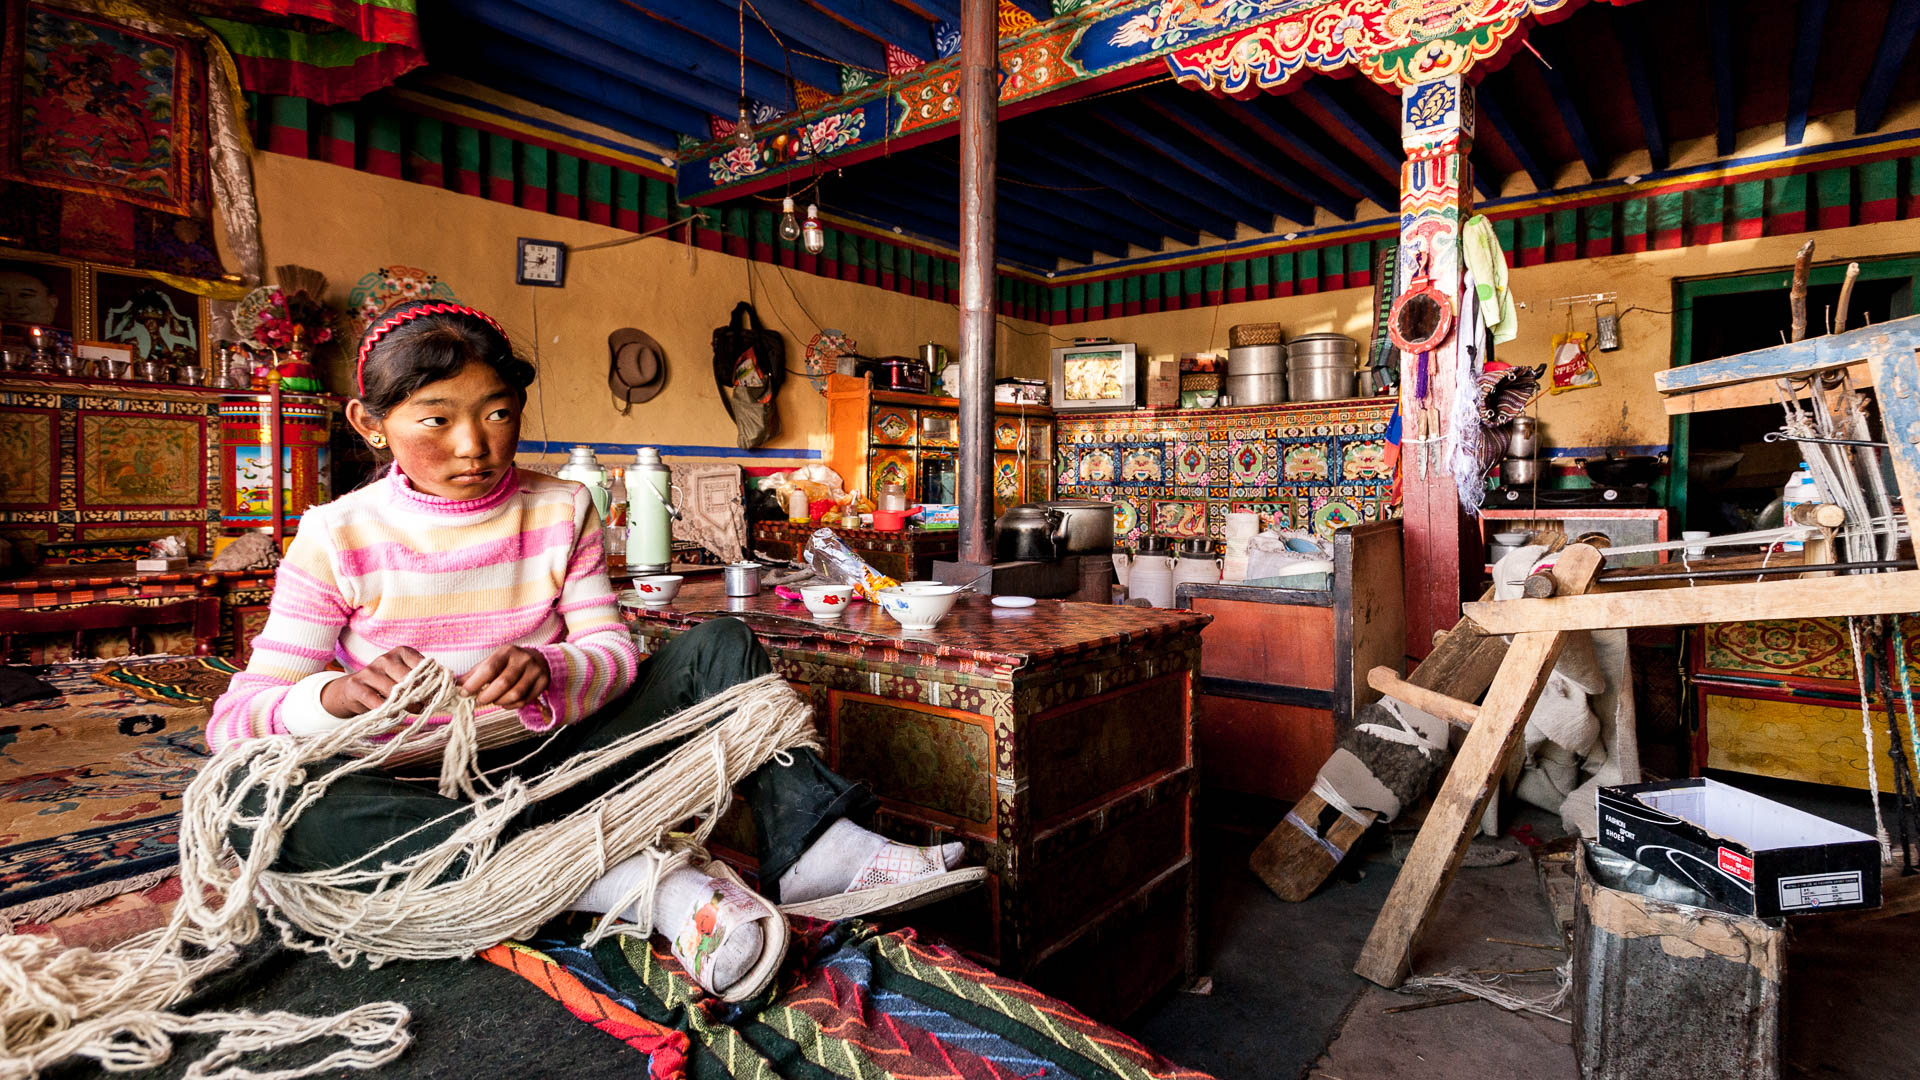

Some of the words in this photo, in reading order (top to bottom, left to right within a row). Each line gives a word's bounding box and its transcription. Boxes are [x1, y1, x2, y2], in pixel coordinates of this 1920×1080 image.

[1605, 814, 1626, 829] FASHION
[1605, 828, 1625, 842] SHOES
[1619, 827, 1635, 840] SPORT
[1721, 850, 1742, 863] FASHION
[1721, 862, 1741, 874] SHOES
[1735, 862, 1751, 873] SPORT
